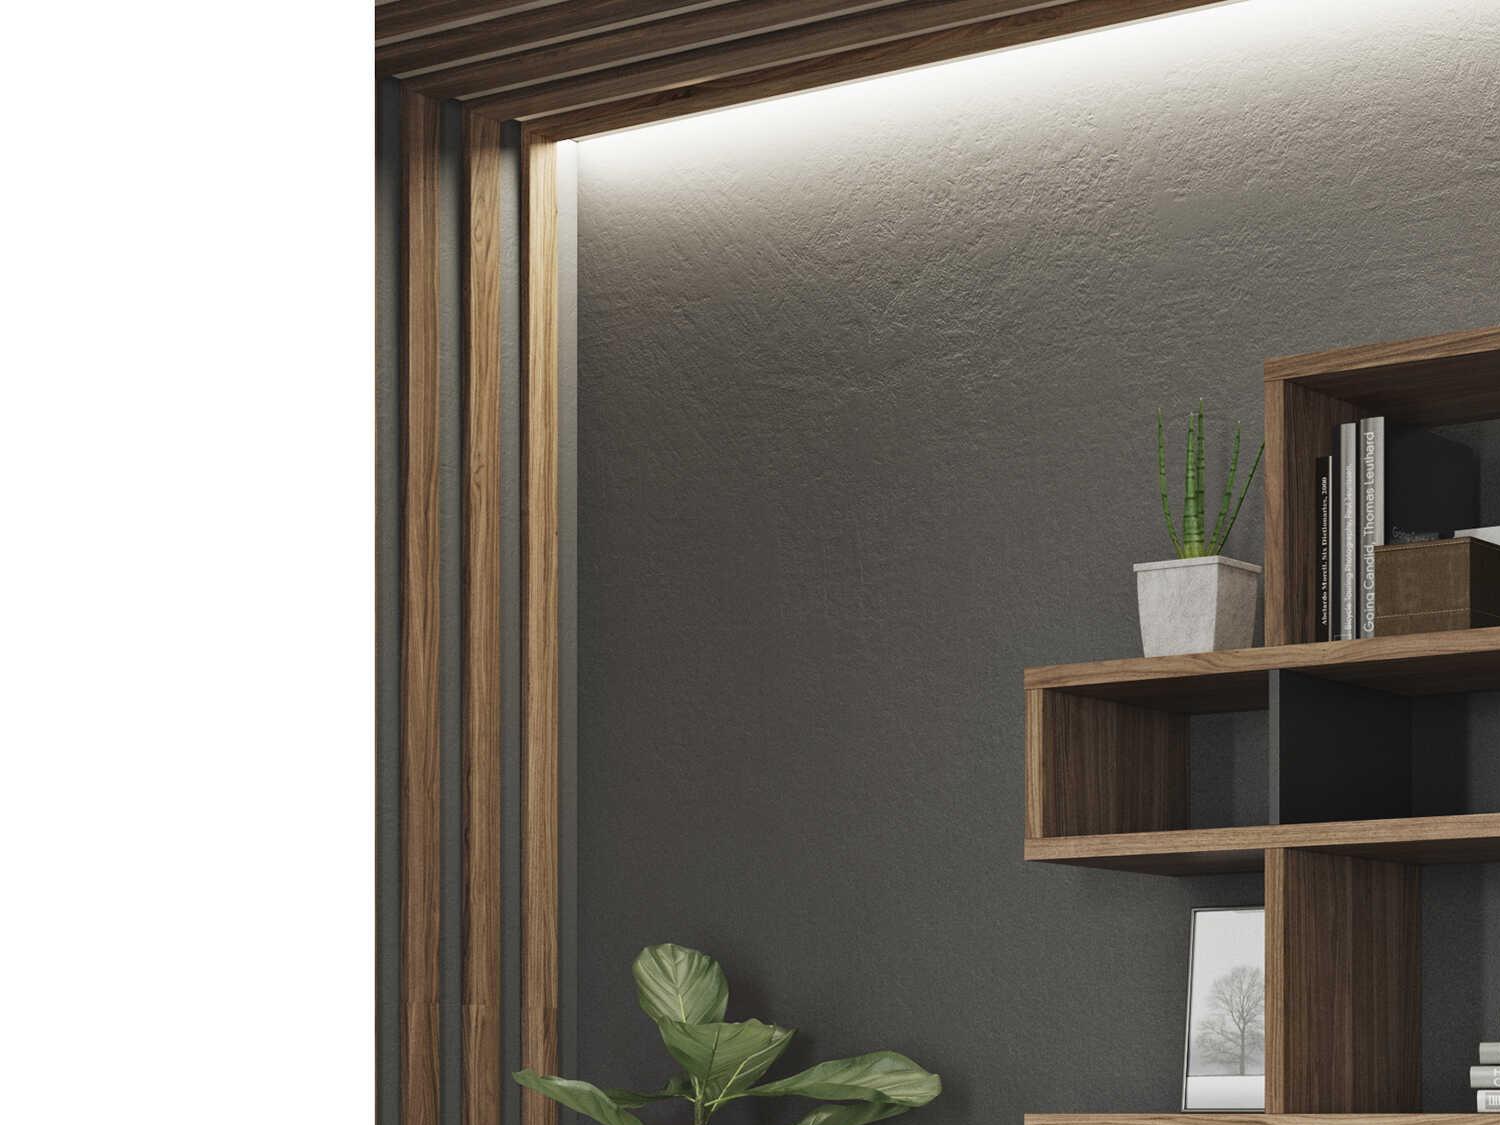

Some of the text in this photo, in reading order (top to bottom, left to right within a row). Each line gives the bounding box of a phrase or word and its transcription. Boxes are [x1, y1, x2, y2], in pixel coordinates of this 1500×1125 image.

[1363, 431, 1375, 485] Leuthard
[1363, 488, 1375, 537] Thomas
[1363, 592, 1375, 632] Going
